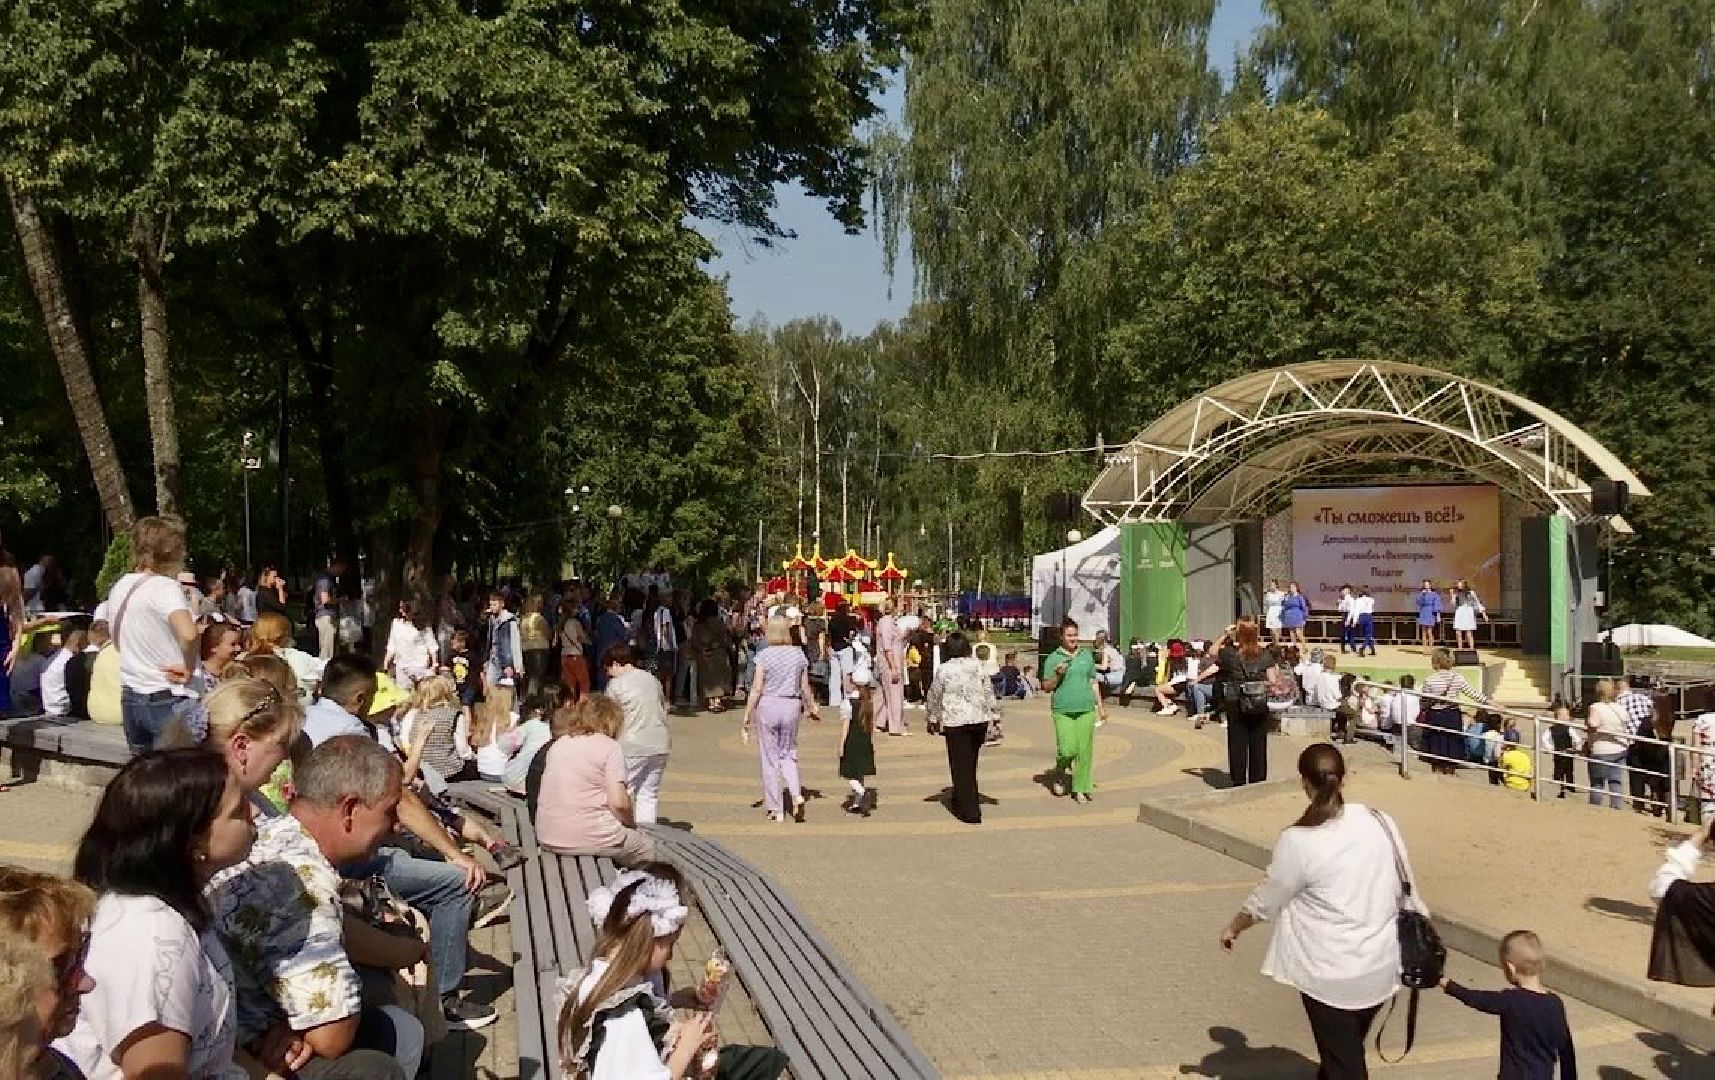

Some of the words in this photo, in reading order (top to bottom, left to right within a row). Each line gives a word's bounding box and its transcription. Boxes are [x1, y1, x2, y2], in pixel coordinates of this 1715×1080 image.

[1314, 507, 1343, 524] «Ты
[1347, 510, 1421, 524] сможешь
[1424, 505, 1465, 524] всё!»
